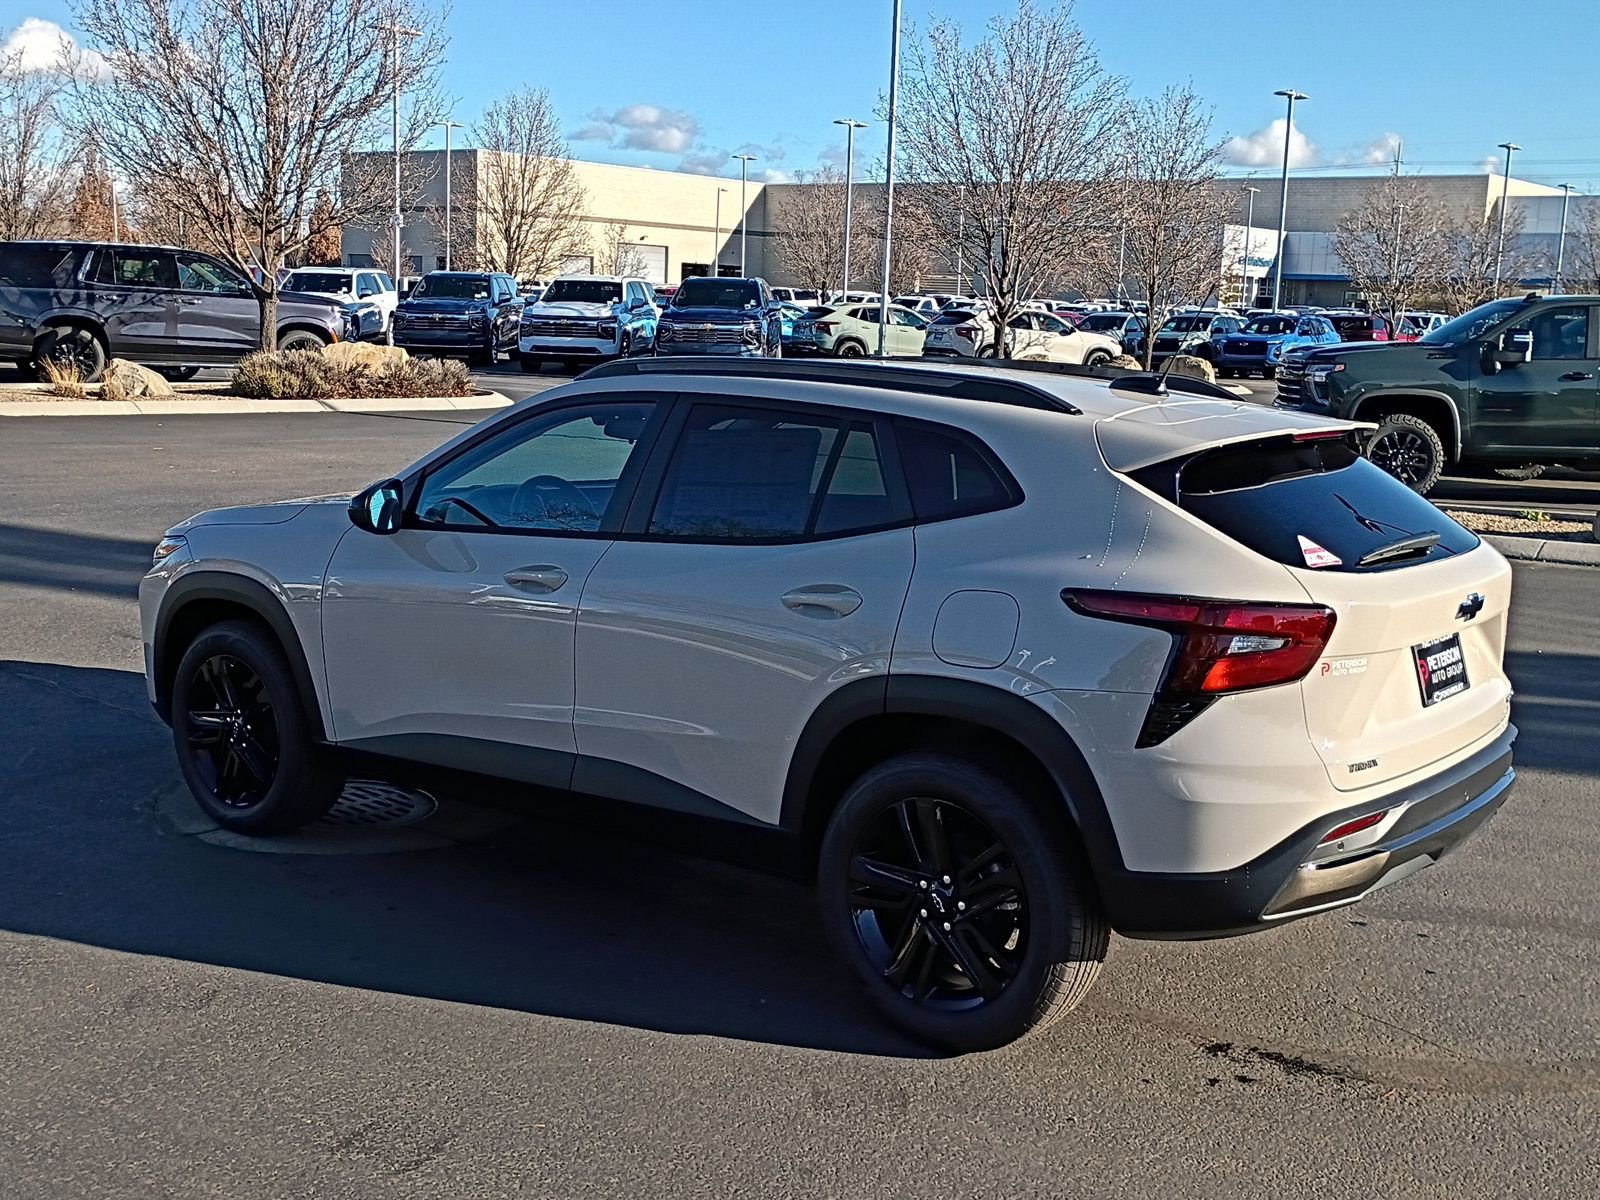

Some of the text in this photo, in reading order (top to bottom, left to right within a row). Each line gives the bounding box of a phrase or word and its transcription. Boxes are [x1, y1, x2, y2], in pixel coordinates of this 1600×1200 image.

[1332, 656, 1368, 671] PETERSON
[1427, 645, 1461, 672] PETERSON
[1431, 661, 1464, 684] AUTO GROUP
